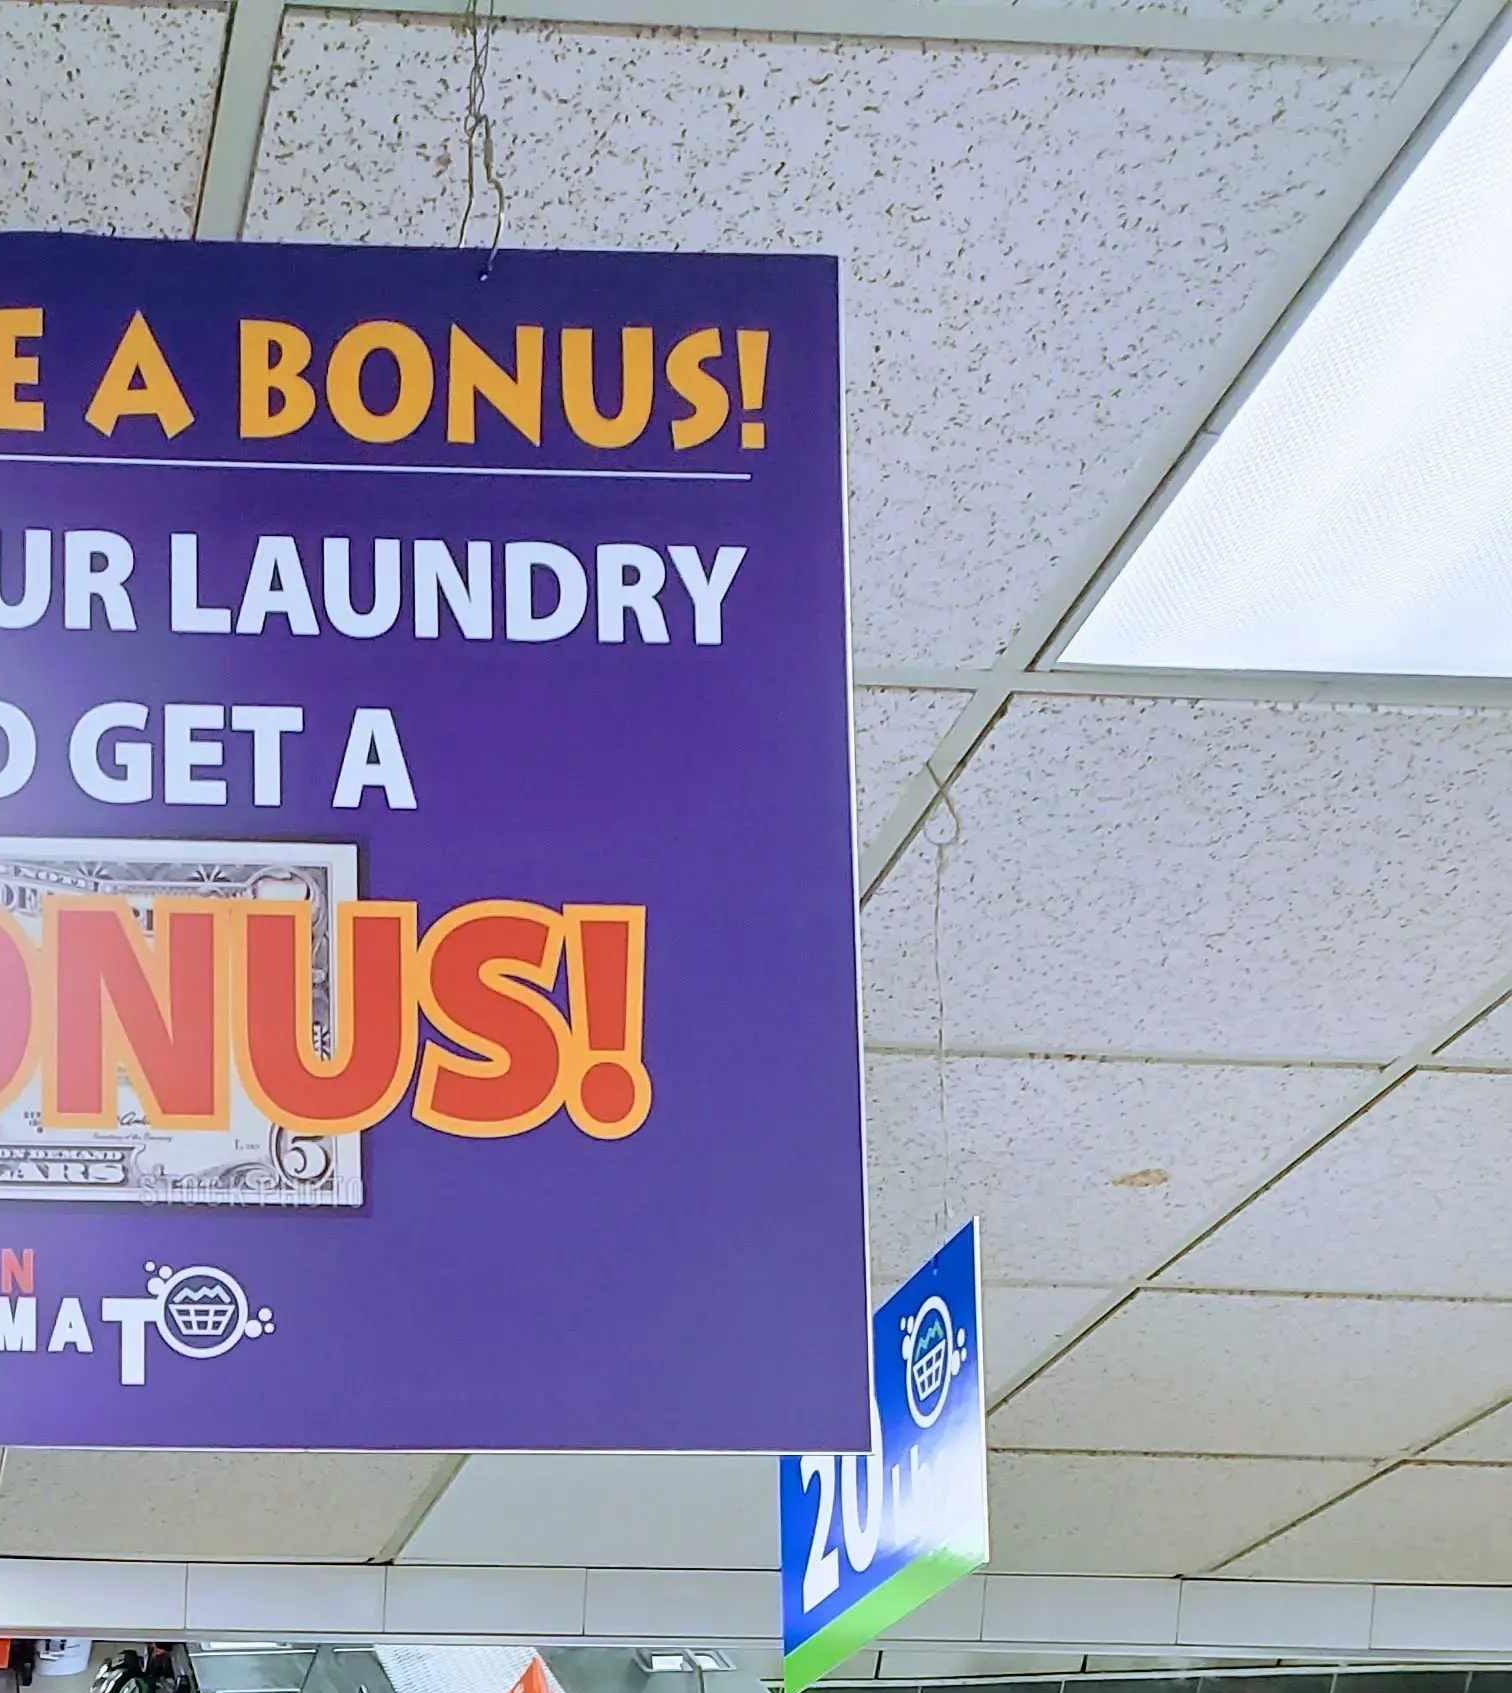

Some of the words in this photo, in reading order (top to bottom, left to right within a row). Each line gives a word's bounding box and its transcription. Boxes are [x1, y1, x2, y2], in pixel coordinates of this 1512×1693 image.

[85, 310, 194, 438] A
[239, 320, 769, 449] BONUS!
[170, 532, 748, 645] LAUNDRY
[68, 701, 304, 807] GET
[332, 708, 418, 810] A
